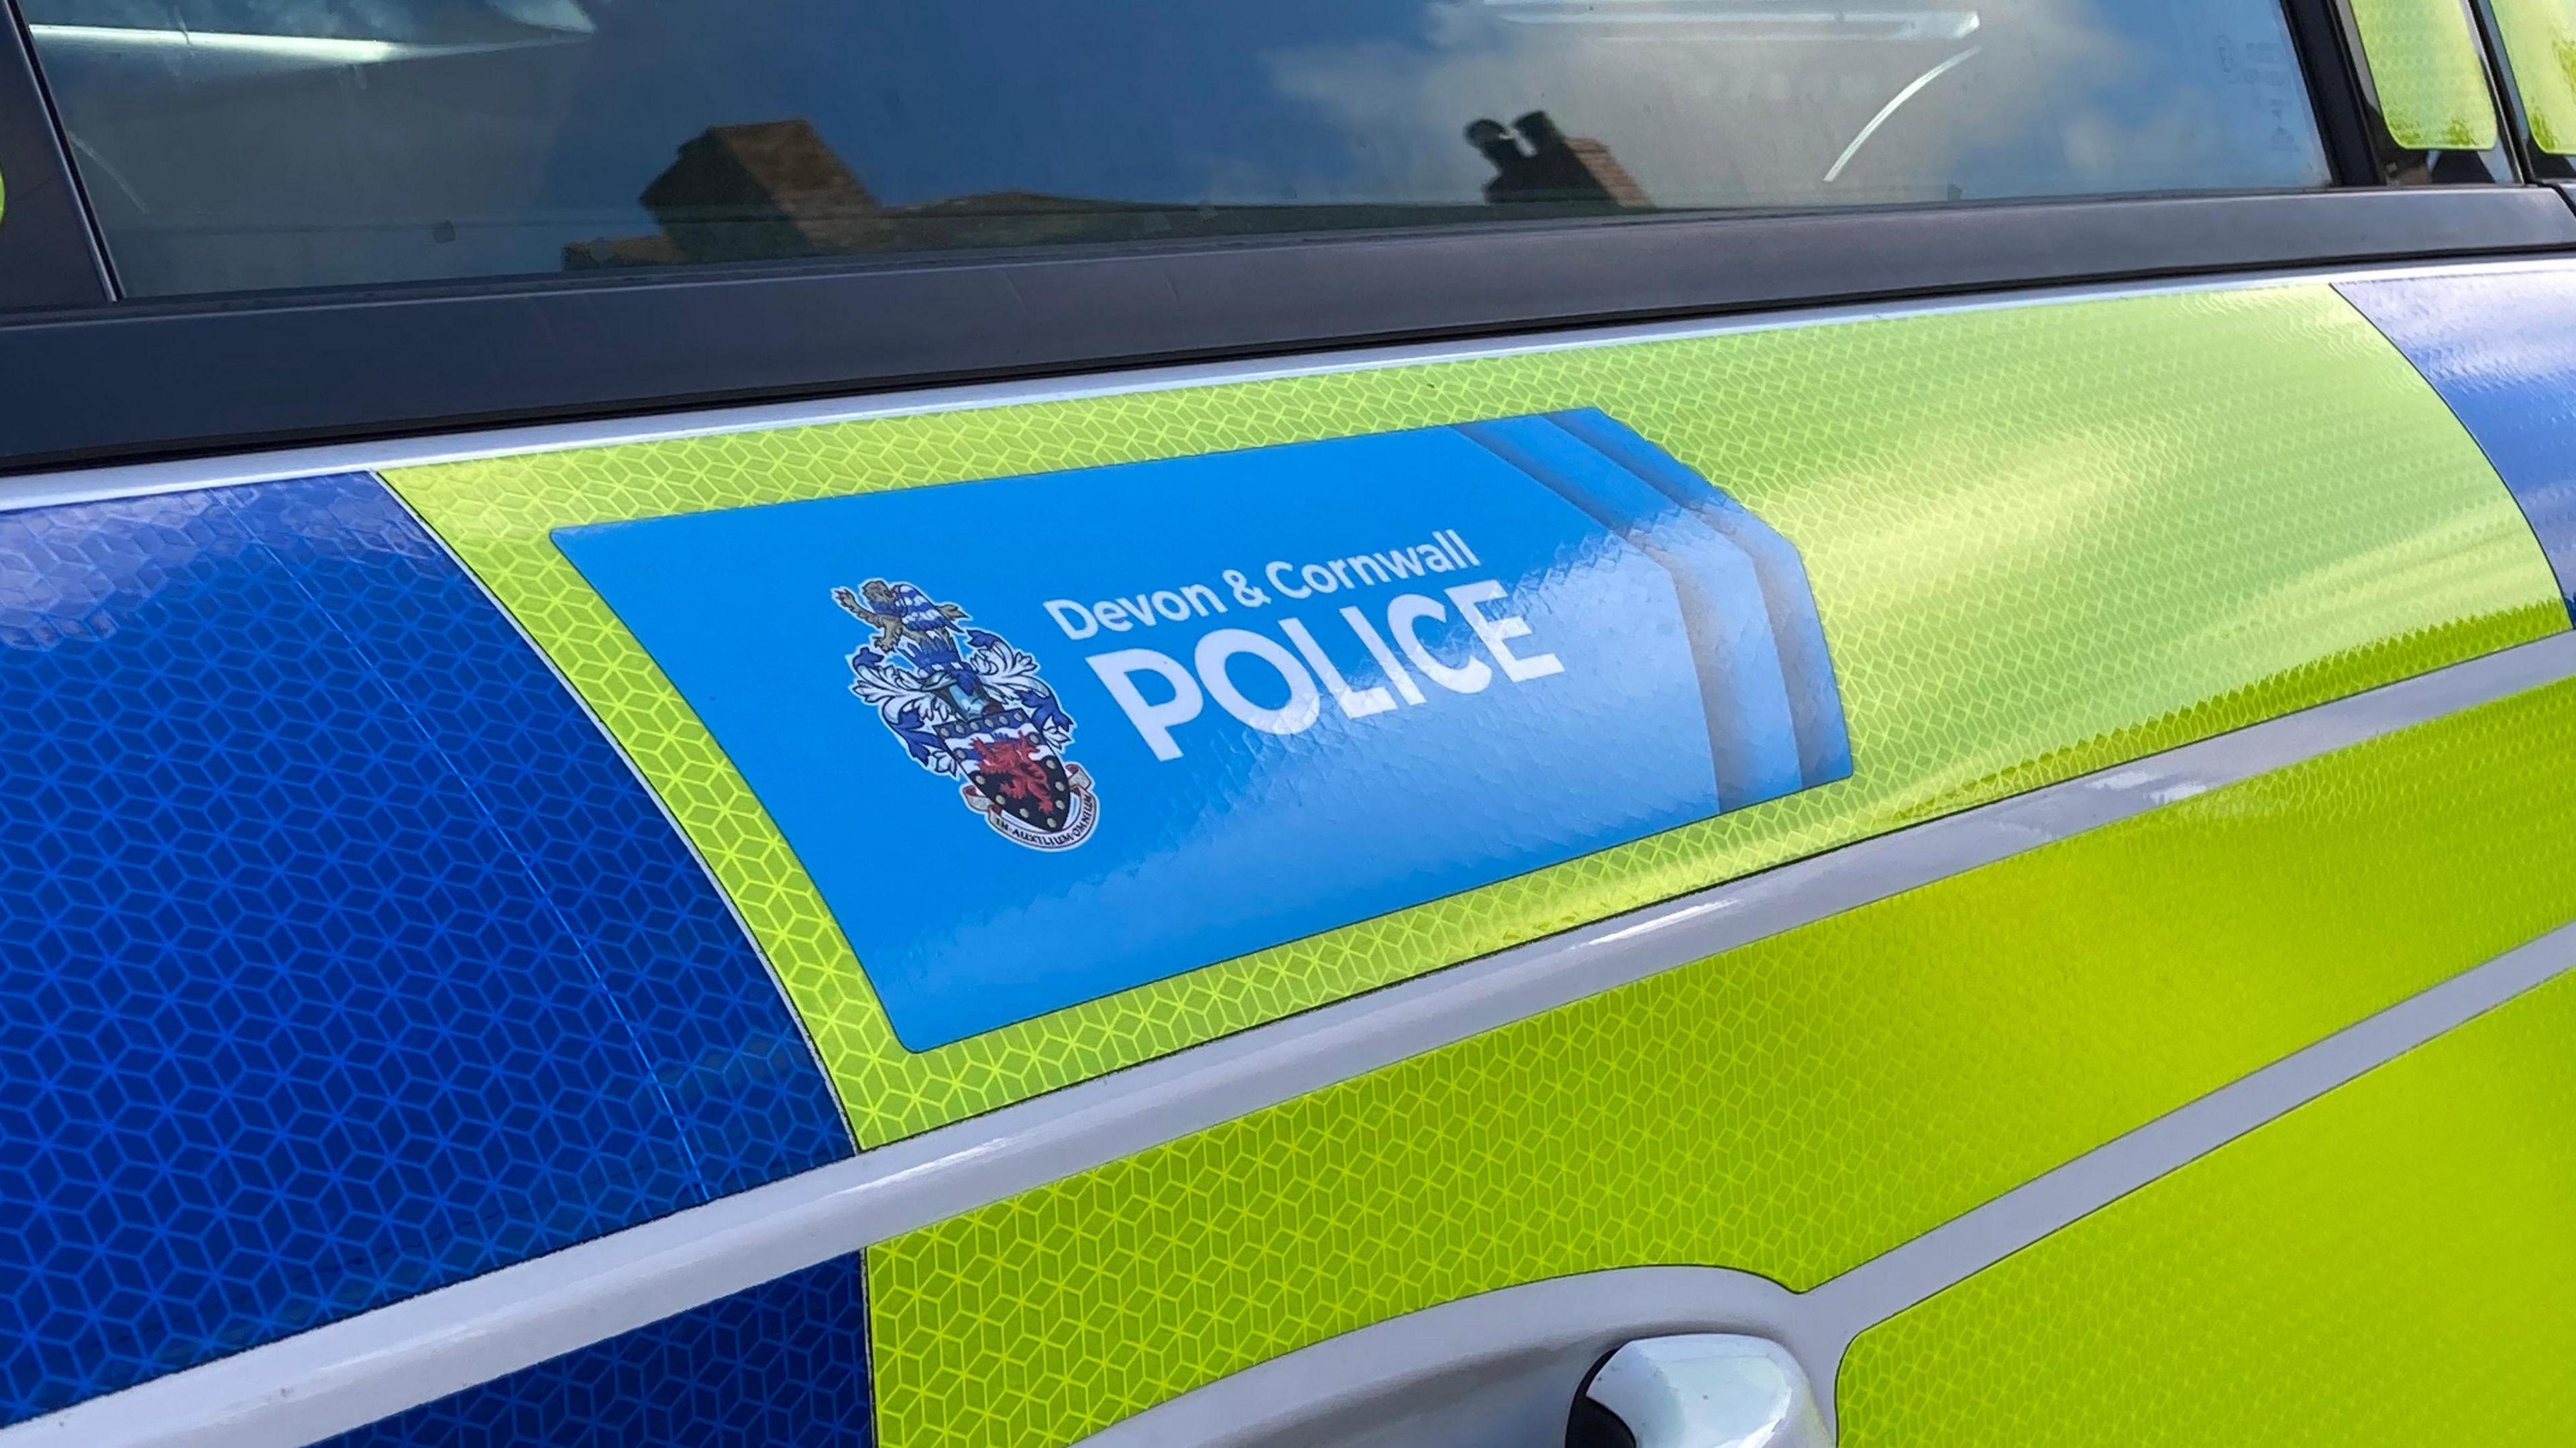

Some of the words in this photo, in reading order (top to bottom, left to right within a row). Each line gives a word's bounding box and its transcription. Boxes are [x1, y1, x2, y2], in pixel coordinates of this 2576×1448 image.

[1043, 581, 1228, 641] Devon
[1222, 569, 1271, 608] &
[1266, 529, 1481, 600] Cornwall
[1085, 579, 1566, 762] POLICE
